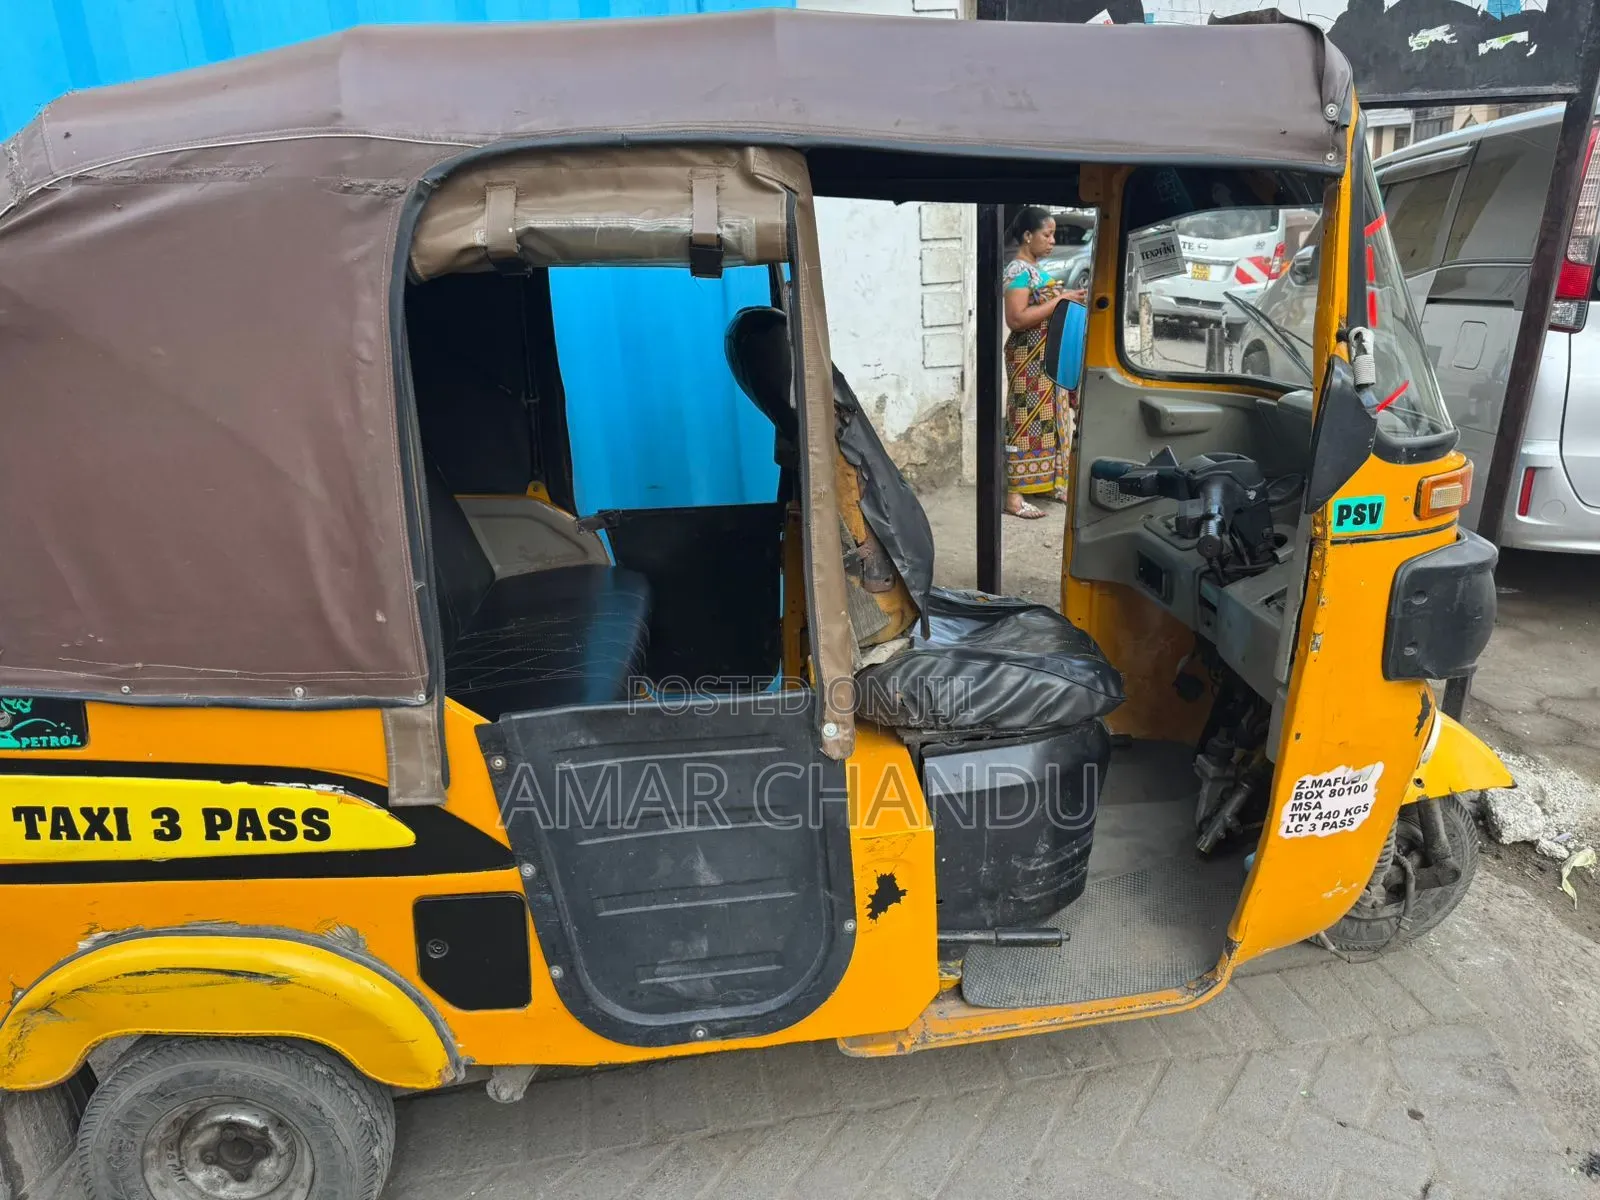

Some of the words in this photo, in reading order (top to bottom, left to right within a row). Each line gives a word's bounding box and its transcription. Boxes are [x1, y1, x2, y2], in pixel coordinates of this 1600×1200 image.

[1336, 502, 1382, 526] PSV
[21, 735, 81, 748] PETROL
[1294, 789, 1324, 801] BOX
[1329, 783, 1368, 798] 80100
[1289, 813, 1311, 823] TW
[1315, 810, 1340, 820] 440
[1344, 803, 1369, 817] KGS
[1291, 801, 1322, 812] MSA
[12, 806, 132, 841] TAXI
[151, 807, 182, 841] 3
[202, 807, 331, 841] PASS
[1285, 824, 1303, 833] LC
[1309, 823, 1316, 832] 3
[1321, 817, 1355, 831] PASS
